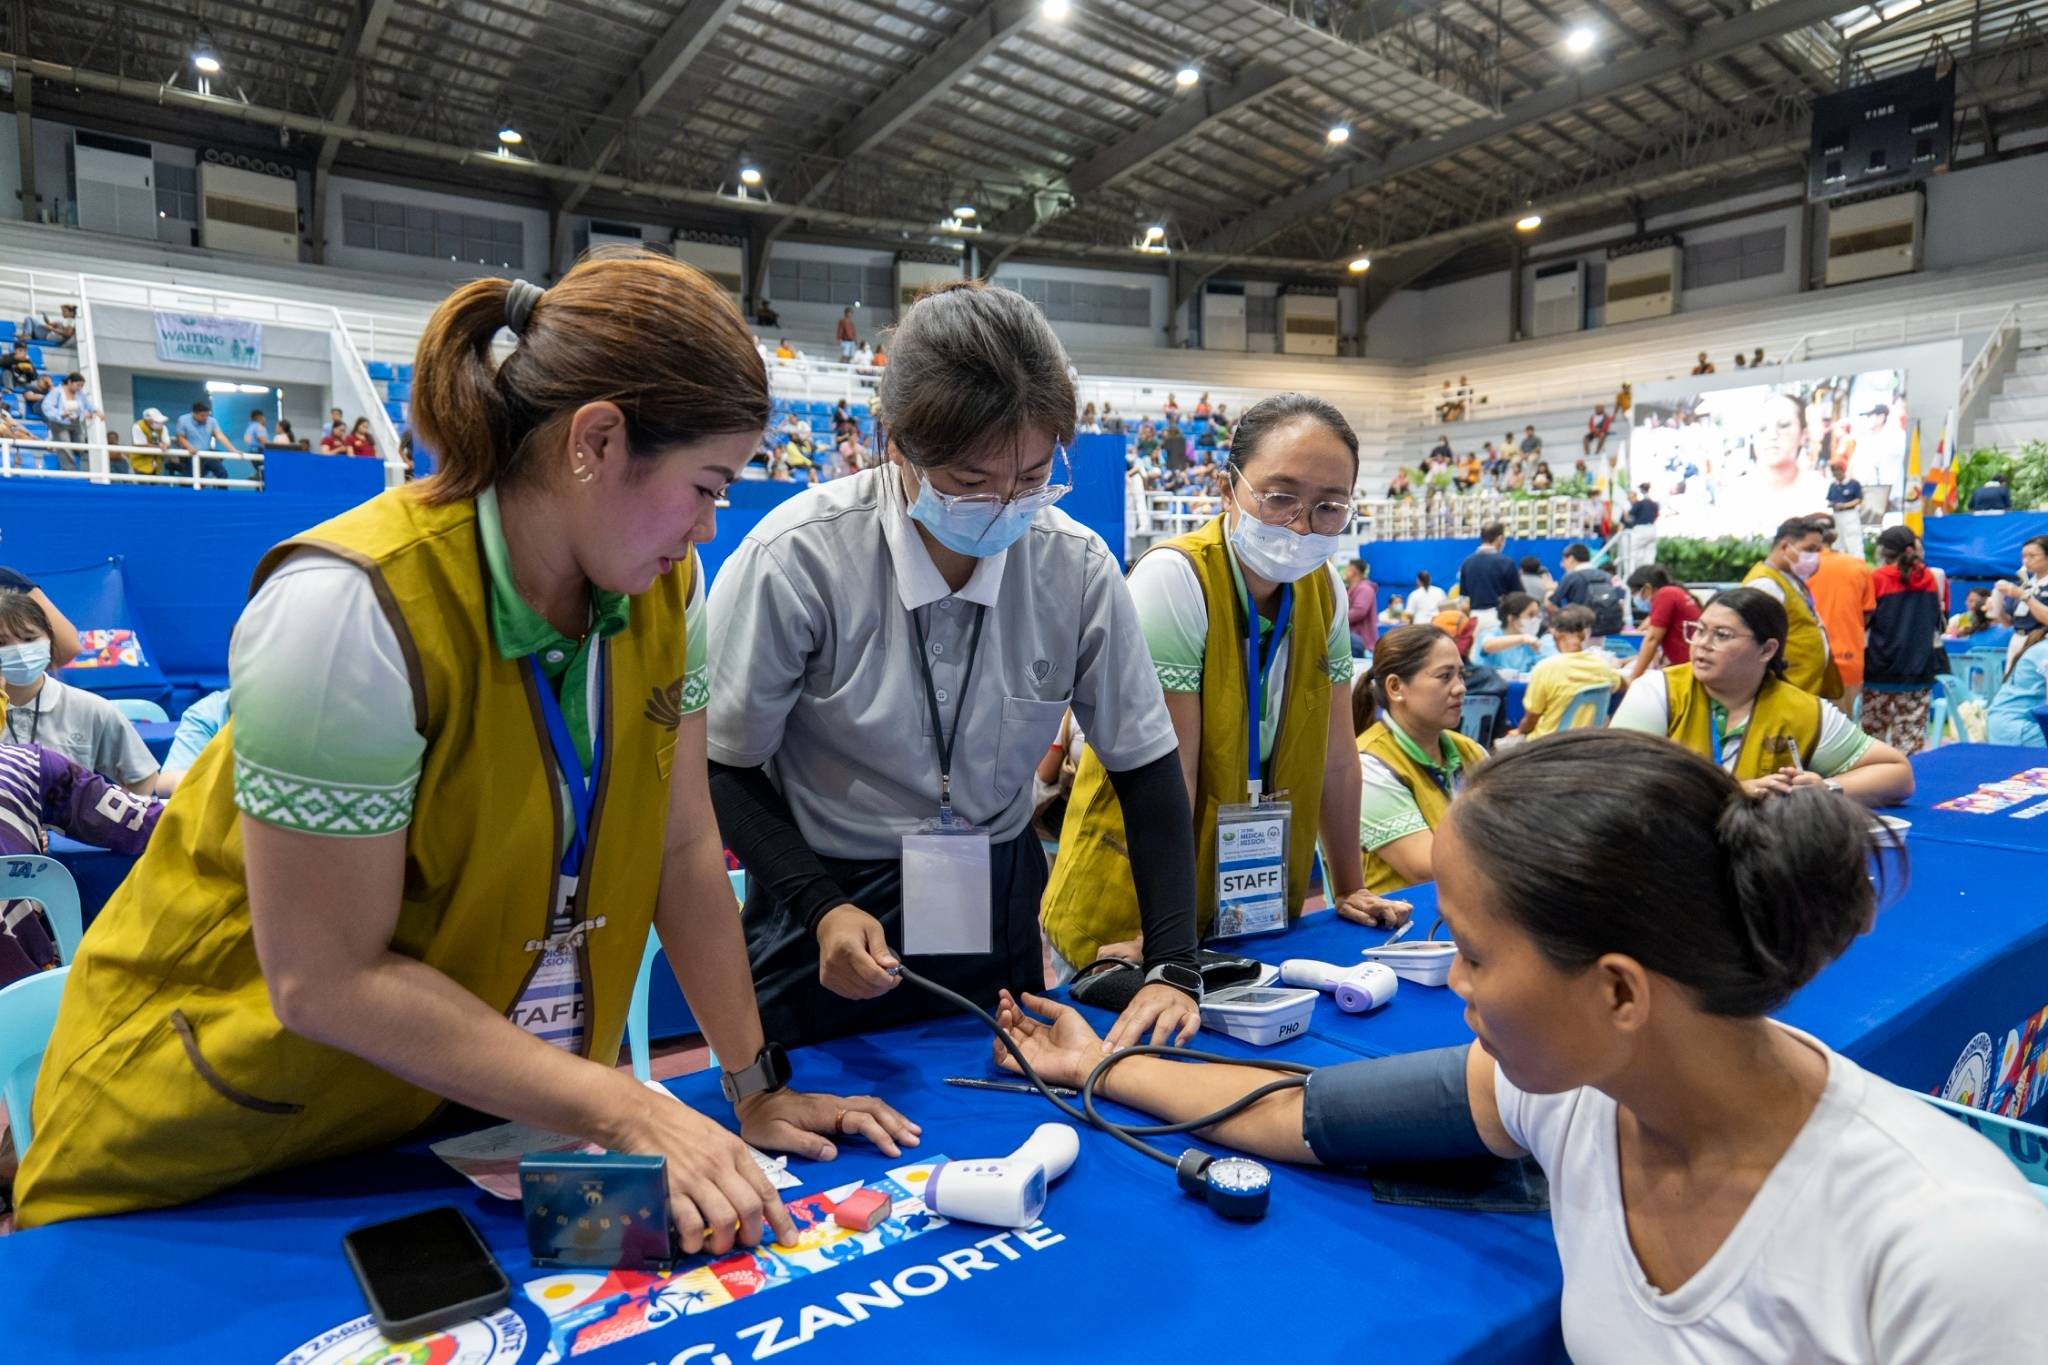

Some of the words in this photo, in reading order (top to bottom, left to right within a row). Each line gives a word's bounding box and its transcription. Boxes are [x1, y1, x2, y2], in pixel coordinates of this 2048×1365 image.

[1865, 105, 1895, 119] TIME
[161, 329, 224, 345] WAITING
[176, 343, 213, 356] AREA
[1224, 871, 1278, 892] STAFF
[511, 1000, 585, 1026] TAFF
[1279, 1022, 1299, 1037] PHO
[736, 1220, 1066, 1361] ZANORTE
